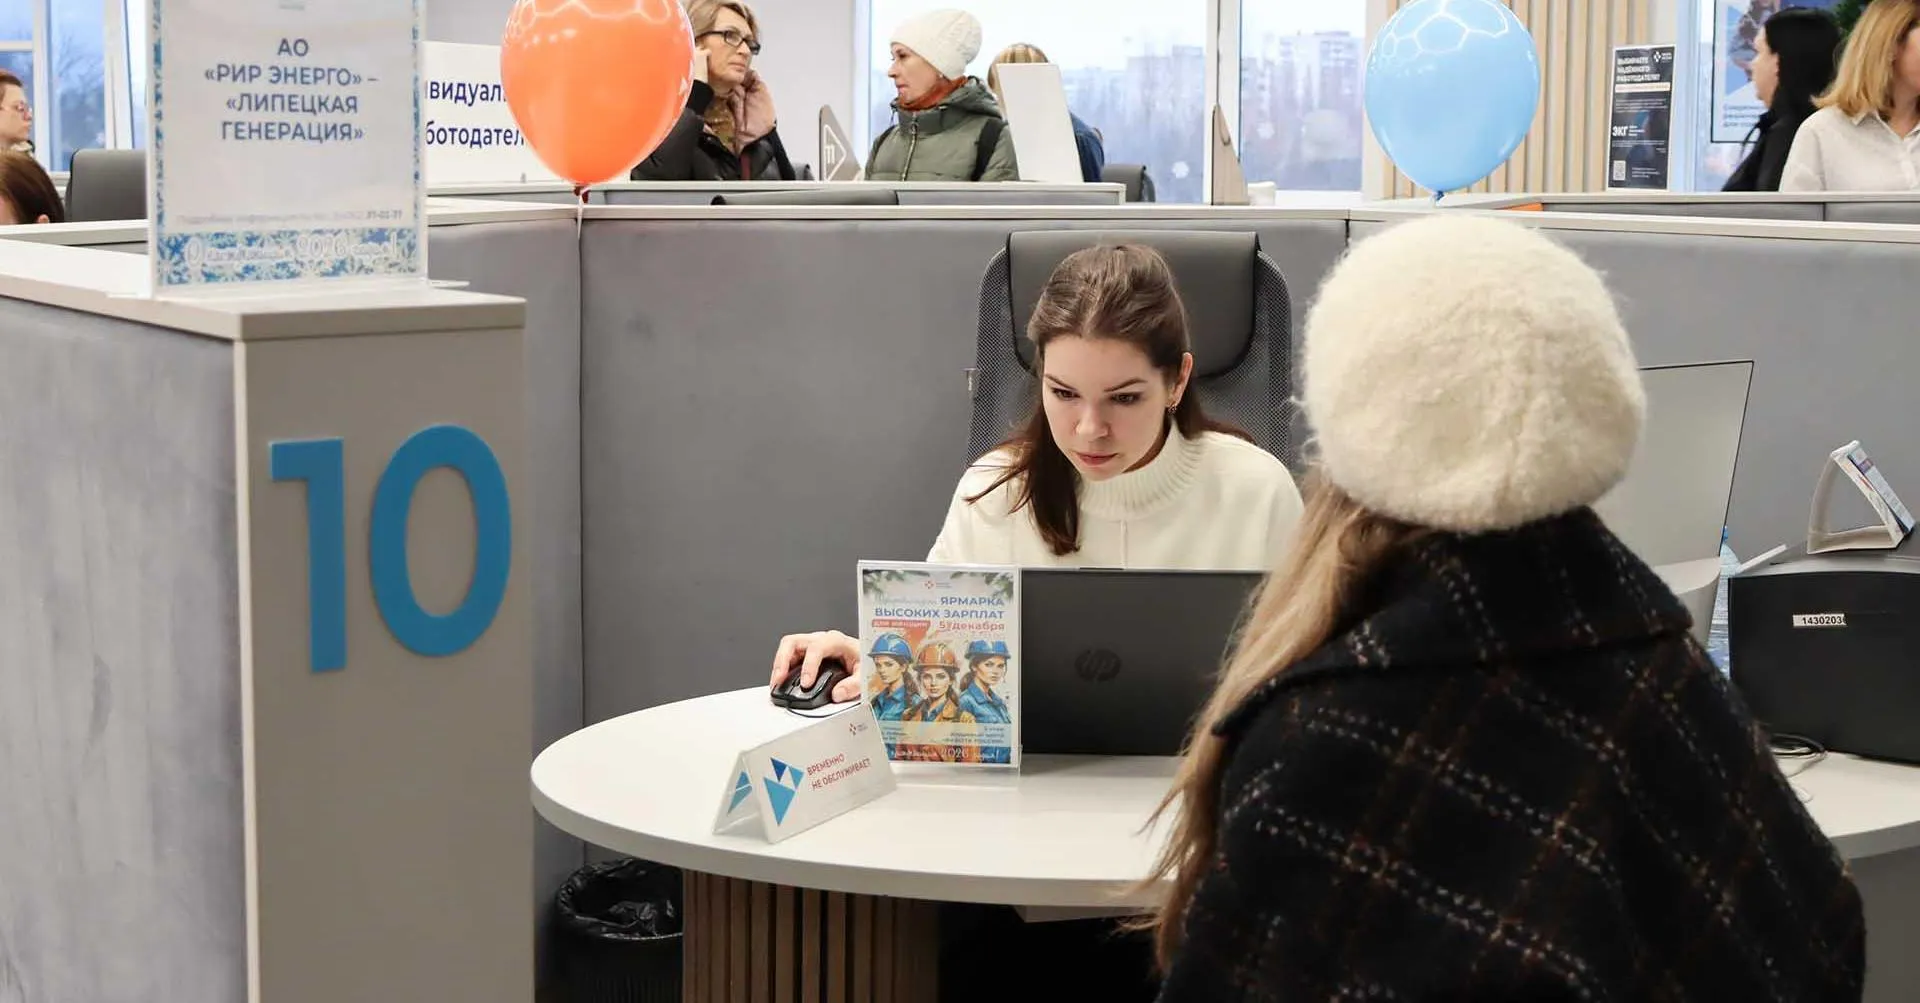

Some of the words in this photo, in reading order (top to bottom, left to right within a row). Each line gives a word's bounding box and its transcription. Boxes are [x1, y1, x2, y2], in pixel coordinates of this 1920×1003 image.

[277, 38, 309, 57] АО
[204, 64, 262, 83] «РИР
[268, 65, 362, 86] ЭНЕРГО»
[226, 93, 358, 115] «ЛИПЕЦКАЯ
[425, 81, 507, 107] видуал
[222, 121, 364, 144] ГЕНЕРАЦИЯ»
[268, 424, 511, 673] 10
[940, 597, 1005, 606] ЯРМАРКА
[875, 608, 940, 618] ВЫСОКИХ
[943, 609, 1006, 619] ЗАРПЛАТ
[807, 753, 845, 776] ВРЕМЕННО
[812, 779, 822, 791] НЕ
[823, 758, 871, 786] ОБСЛУЖИВАЕТ
